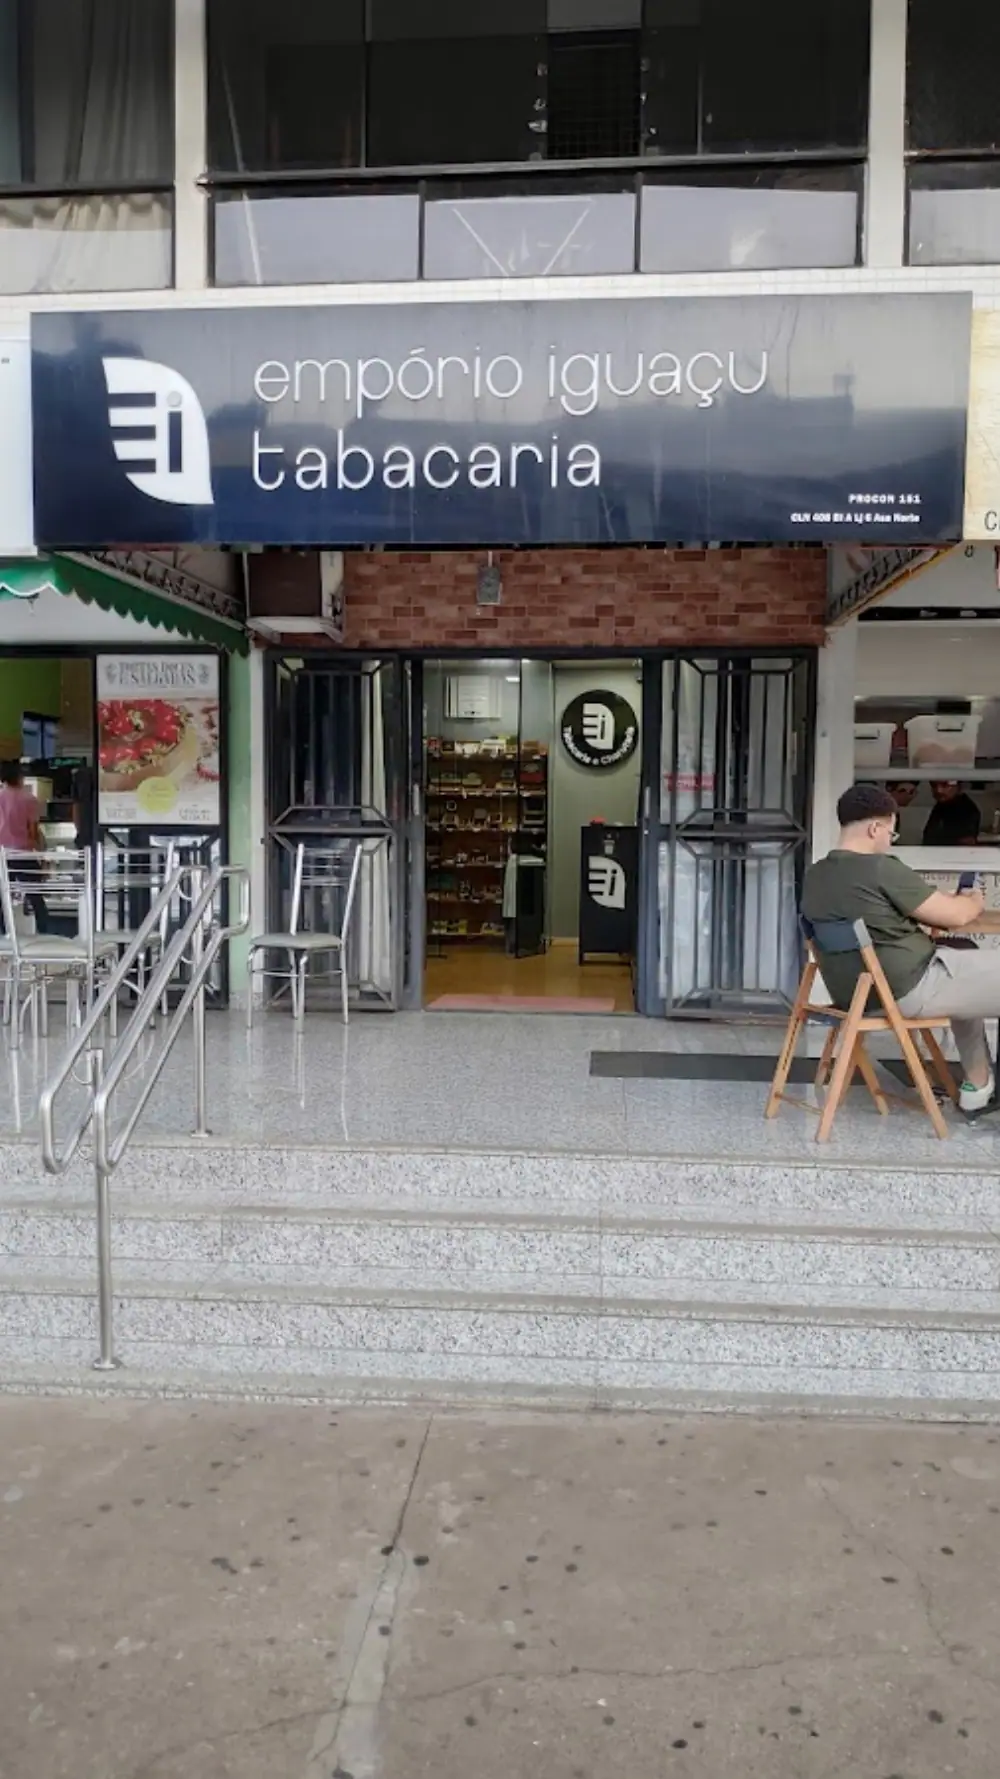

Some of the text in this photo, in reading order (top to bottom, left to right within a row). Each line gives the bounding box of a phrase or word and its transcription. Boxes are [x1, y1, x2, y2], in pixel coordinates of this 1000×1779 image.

[254, 344, 768, 418] empório iguaçu
[252, 427, 602, 491] tabacaria
[848, 493, 895, 504] PROCON
[893, 512, 920, 522] Norte
